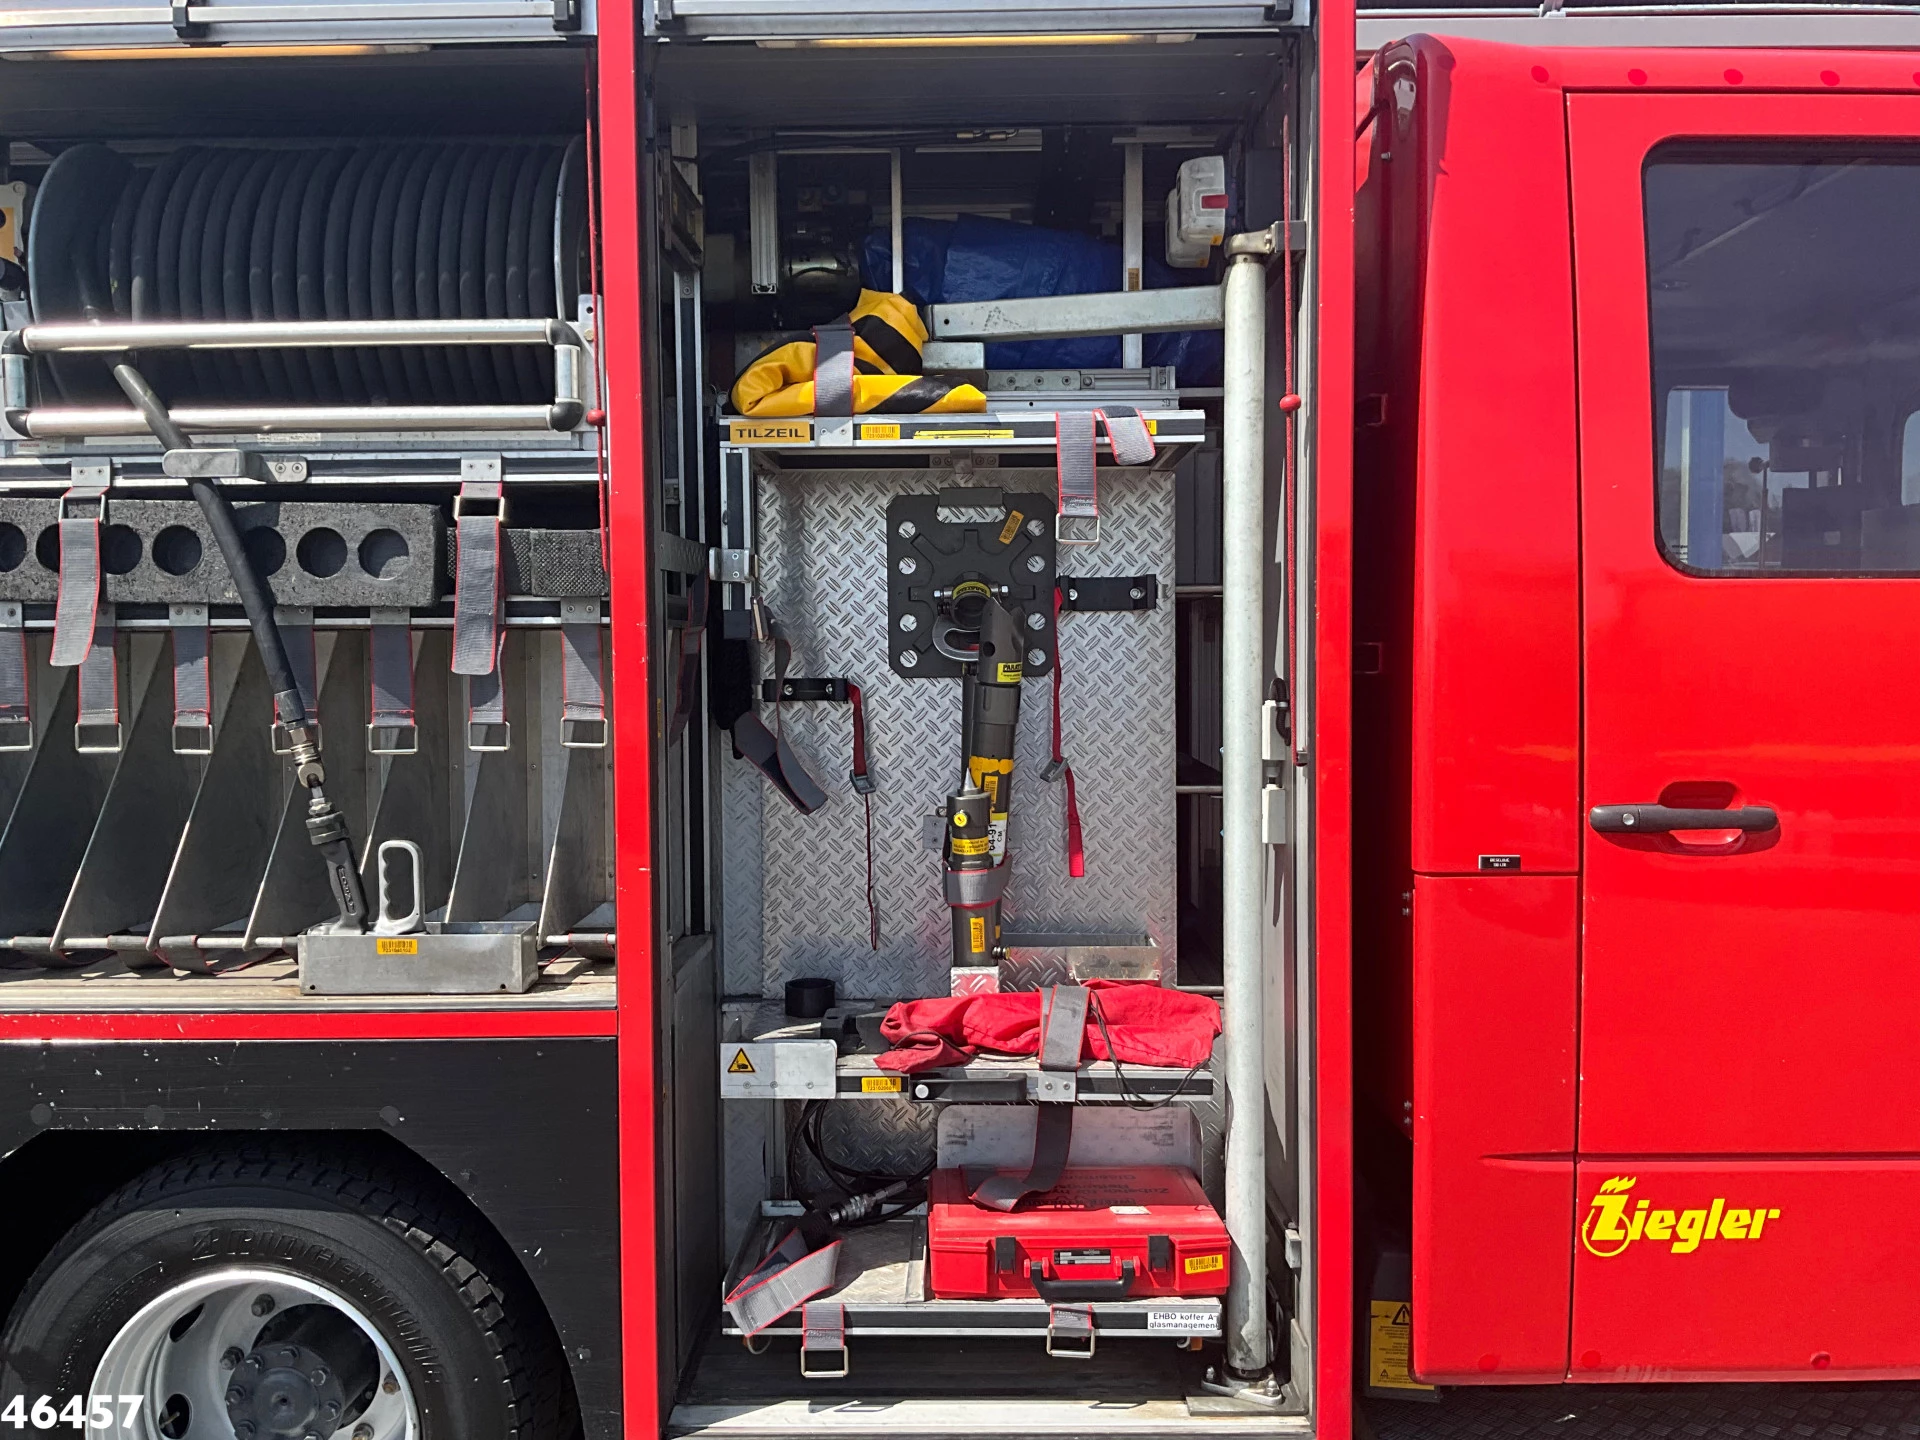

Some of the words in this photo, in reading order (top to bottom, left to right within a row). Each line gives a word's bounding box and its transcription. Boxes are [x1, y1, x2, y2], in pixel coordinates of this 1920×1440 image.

[736, 428, 805, 438] TILZEIL
[1584, 1189, 1781, 1256] Ziegler
[1153, 1312, 1177, 1320] EHBO
[1180, 1312, 1205, 1321] koffer
